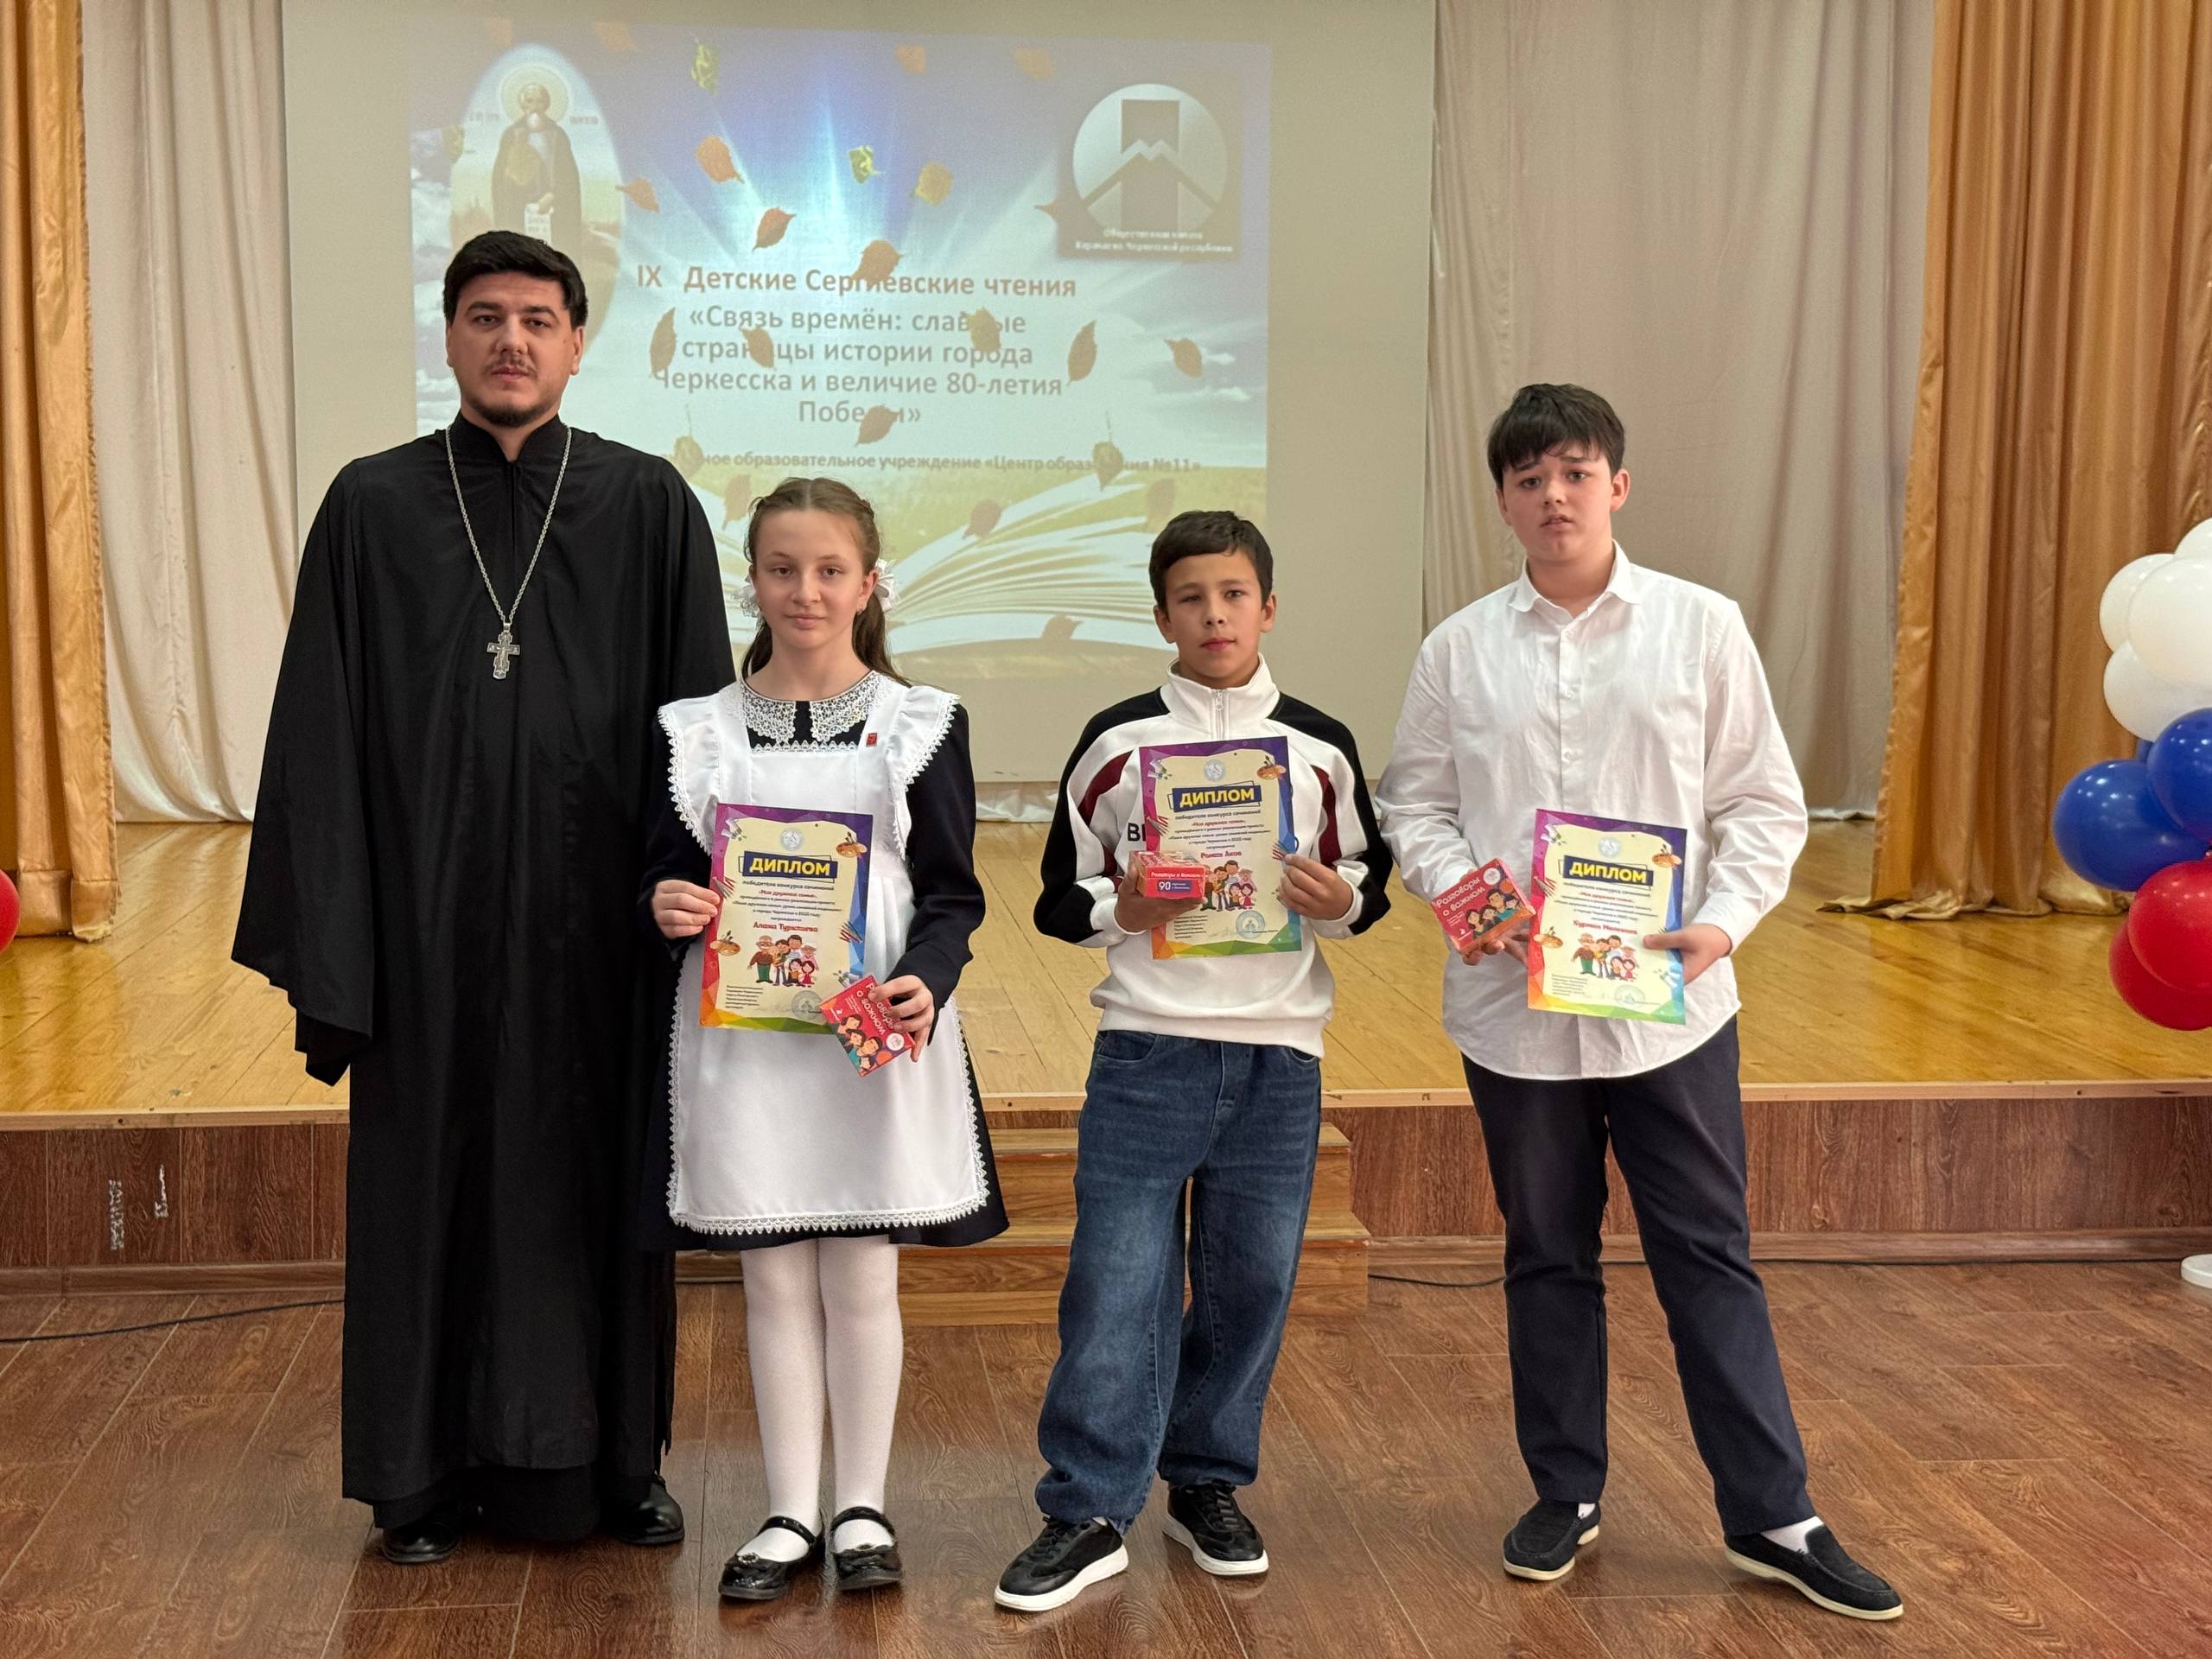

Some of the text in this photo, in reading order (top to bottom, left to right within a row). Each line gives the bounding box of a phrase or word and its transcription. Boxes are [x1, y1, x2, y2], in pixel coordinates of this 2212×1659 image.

[637, 264, 663, 288] IX
[683, 266, 797, 293] Детские
[983, 277, 1077, 297] чтения
[690, 305, 1027, 334] «Связь времён: славые
[683, 340, 1033, 368] странцы истории города
[653, 366, 1063, 395] Черкесска и величие 80-летия
[799, 399, 921, 423] Побе»
[734, 451, 876, 468] образовательное
[879, 454, 982, 471] учреждение
[984, 455, 1044, 472] «Центр
[1046, 456, 1150, 473] образния
[1179, 787, 1255, 809] ДИПЛОМ
[749, 857, 831, 877] ДИПЛОМ
[1568, 861, 1647, 884] ДИПЛОМ
[1159, 880, 1171, 891] 90
[1436, 876, 1480, 908] Разговоры
[1450, 887, 1485, 912] важном
